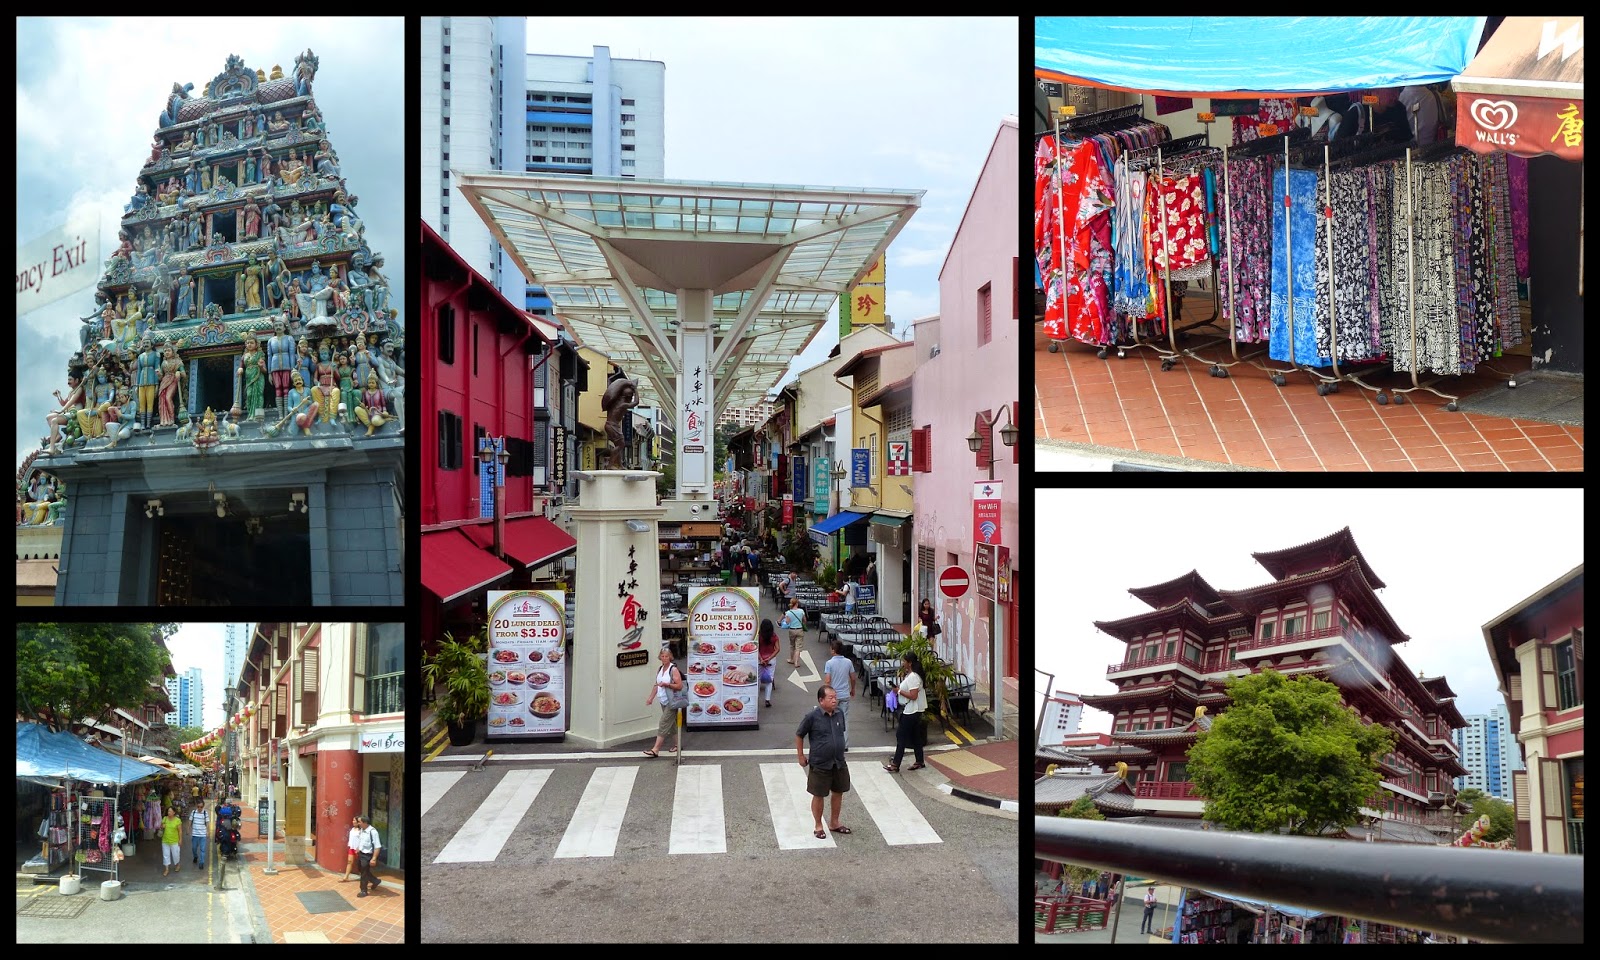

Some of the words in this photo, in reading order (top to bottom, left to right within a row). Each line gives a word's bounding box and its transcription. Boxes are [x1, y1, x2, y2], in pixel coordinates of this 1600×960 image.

[1551, 103, 1584, 148] 唐
[1475, 130, 1516, 145] WALL'S
[51, 235, 86, 278] Exit
[892, 444, 904, 452] 7
[694, 613, 708, 622] 20
[494, 619, 509, 629] 20
[718, 621, 753, 632] $3.50
[520, 628, 558, 639] $3.50
